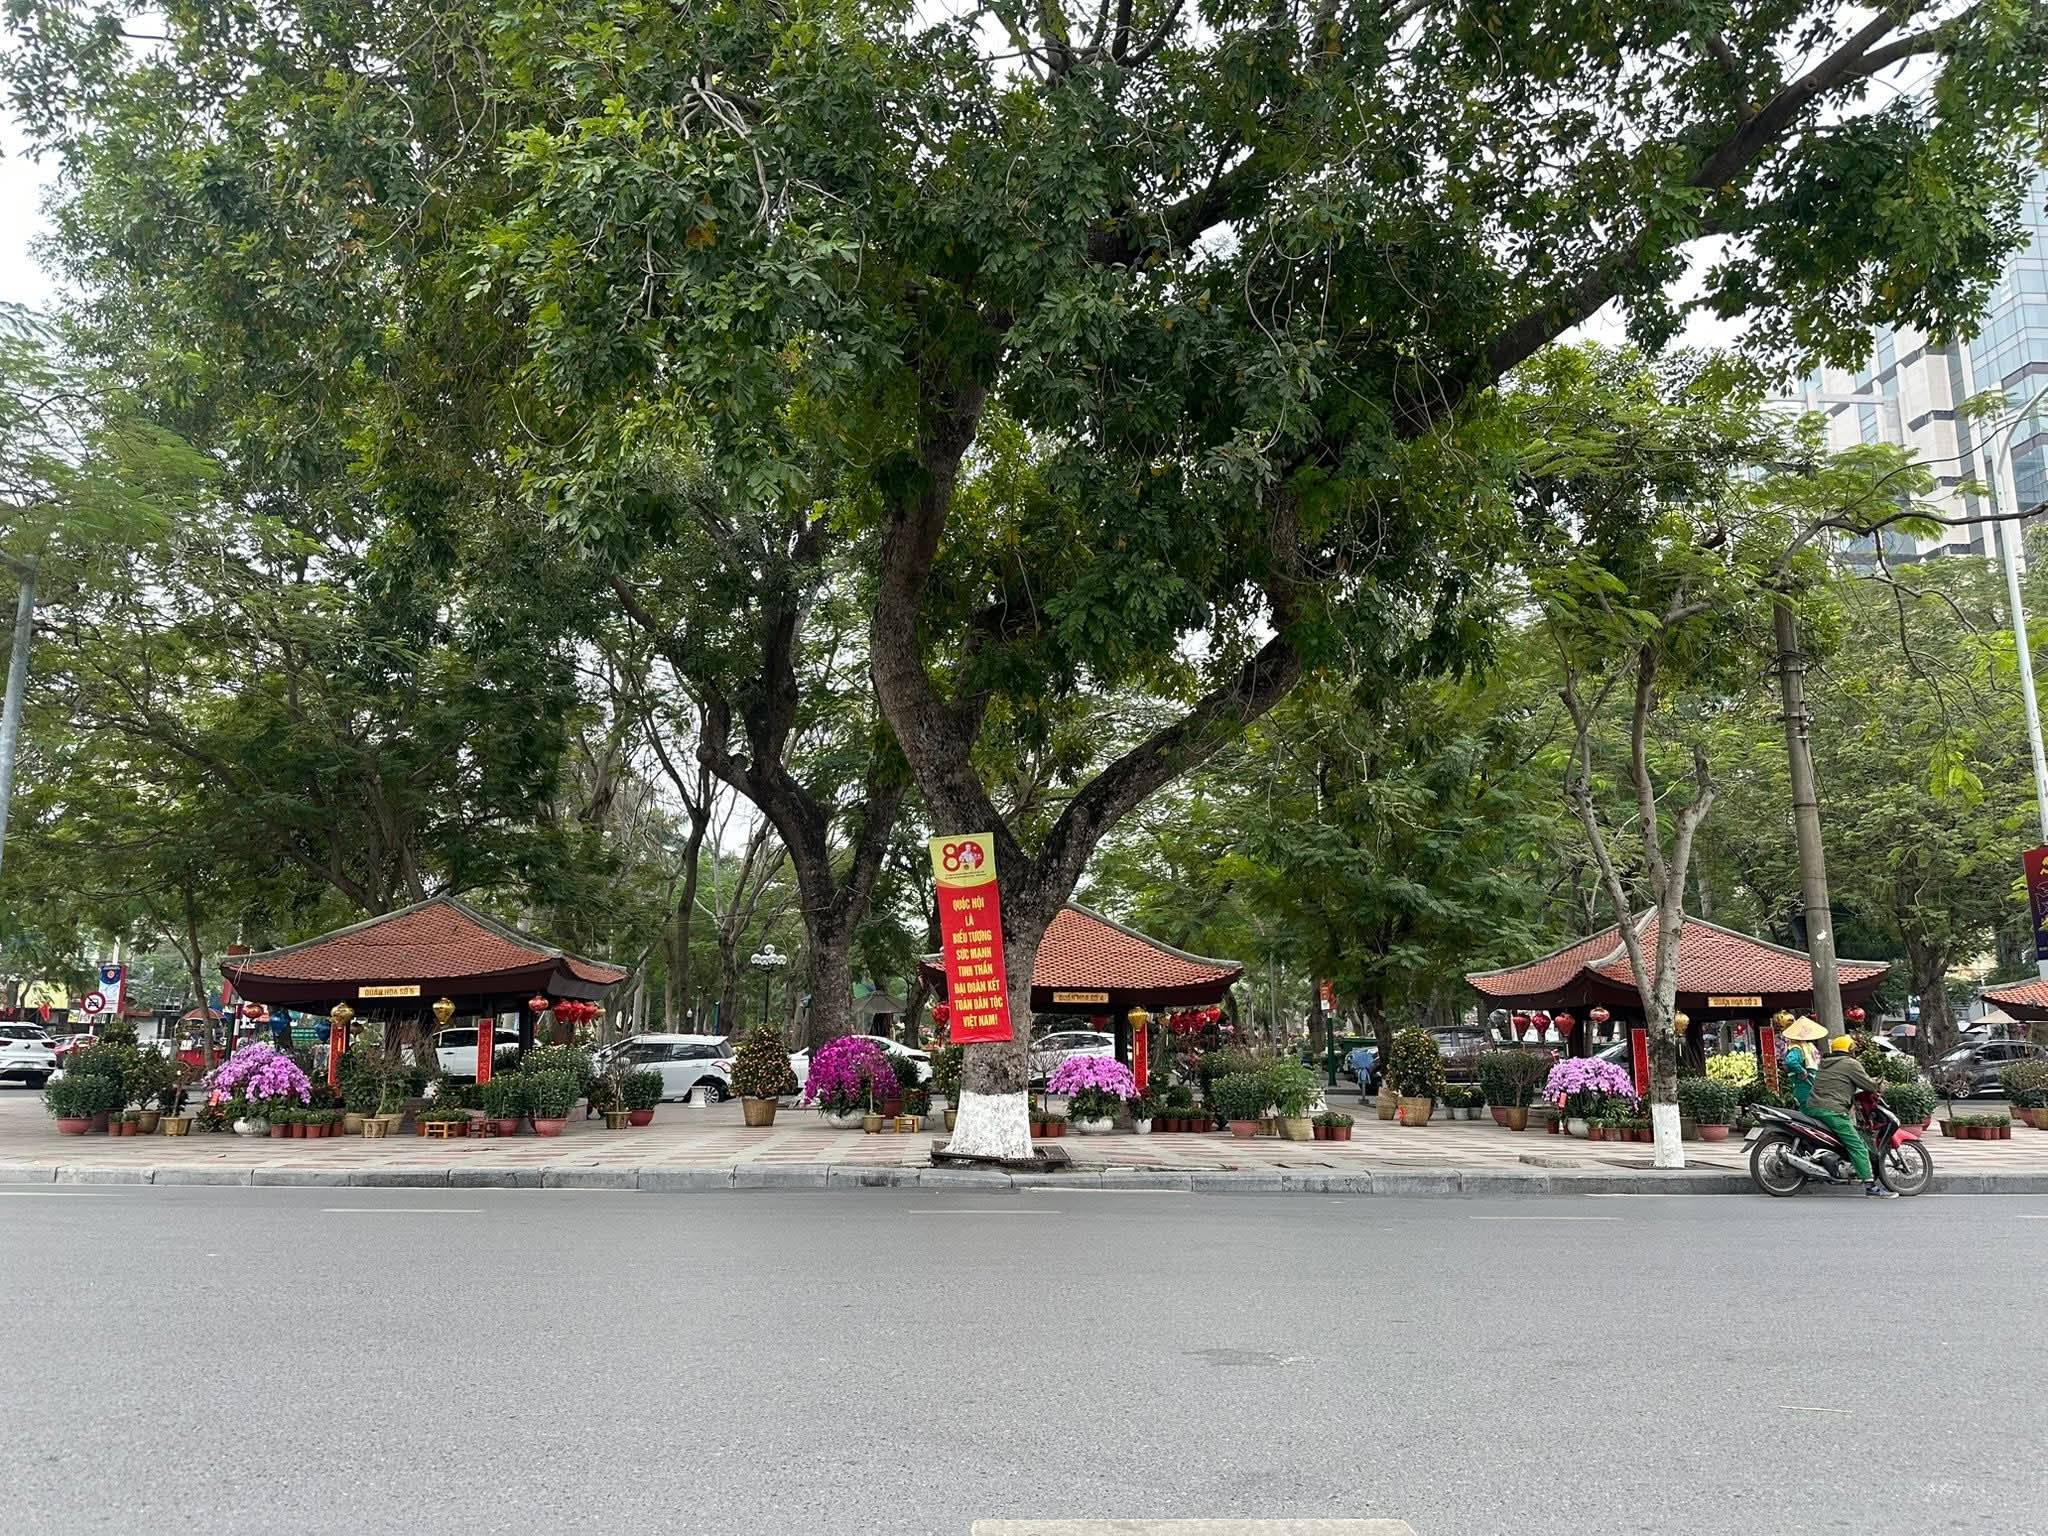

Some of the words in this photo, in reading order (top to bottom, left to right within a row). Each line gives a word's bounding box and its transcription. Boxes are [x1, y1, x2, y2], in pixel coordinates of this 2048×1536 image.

[953, 896, 970, 912] QUỐC
[971, 896, 984, 911] HỘI
[965, 913, 974, 927] LÀ
[952, 929, 967, 944] BIỂU
[968, 930, 992, 944] TƯỢNG
[956, 946, 969, 960] SỨC
[970, 947, 992, 961] MẠNH
[958, 965, 973, 977] TINH
[974, 960, 992, 976] THẦN
[954, 982, 966, 997] ĐẠI
[967, 979, 986, 993] ĐOÀN
[987, 976, 999, 992] KẾT
[954, 998, 973, 1011] TOÀN
[974, 996, 988, 1010] DÂN
[989, 995, 1003, 1010] TỘC
[963, 1013, 977, 1029] VIỆT
[979, 1013, 998, 1027] NAM!
